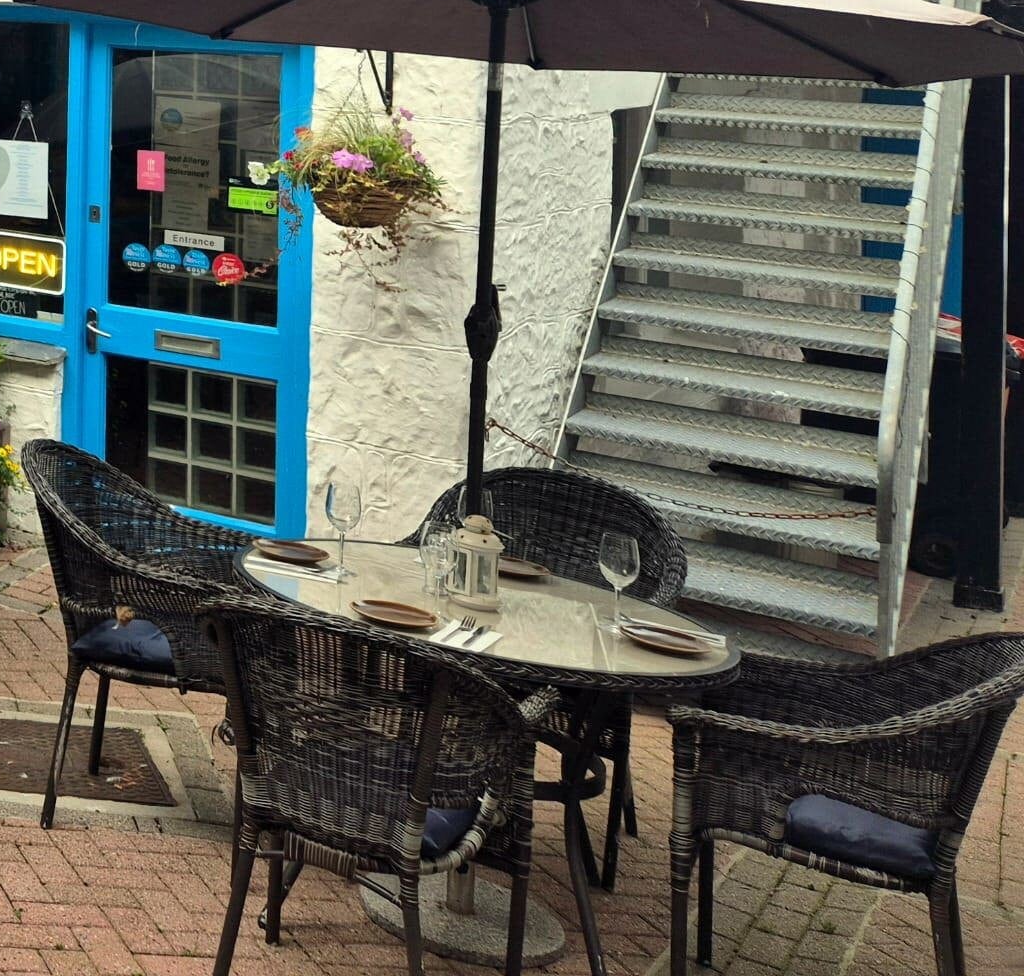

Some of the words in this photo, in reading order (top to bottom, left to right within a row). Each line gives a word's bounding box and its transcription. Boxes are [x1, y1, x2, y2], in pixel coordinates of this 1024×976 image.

[182, 156, 210, 166] Allergy
[172, 234, 215, 247] Entrance
[127, 260, 146, 269] GOLD
[157, 261, 176, 270] GOLD
[186, 266, 206, 275] GOLD
[0, 299, 26, 315] OPEN
